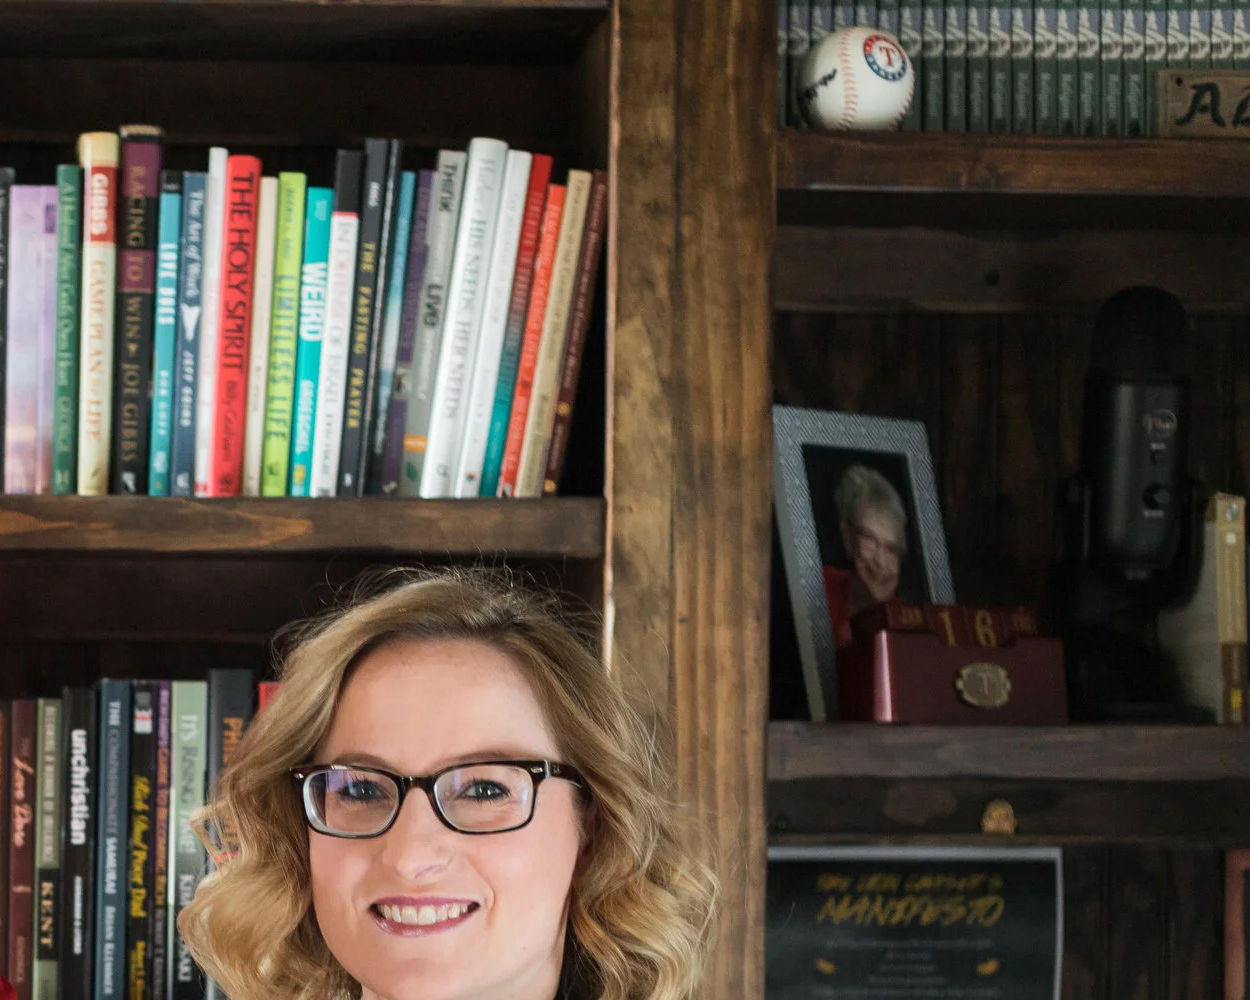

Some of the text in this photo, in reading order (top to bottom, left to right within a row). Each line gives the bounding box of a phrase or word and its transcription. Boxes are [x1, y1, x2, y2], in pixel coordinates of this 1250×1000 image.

[91, 173, 108, 235] GIBBS
[188, 221, 202, 242] Art
[125, 166, 147, 338] RACING TO WIN
[223, 172, 254, 376] THE HOLY SPIRIT
[90, 260, 106, 313] GAME
[300, 261, 328, 342] WEIRD
[89, 322, 103, 374] PLAN
[269, 275, 297, 384] LIMITLESS
[348, 242, 376, 429] THE FASTING PRAYER
[87, 401, 102, 440] LIFE
[122, 364, 141, 462] JOE GIBBS
[265, 395, 287, 441] LIFE
[974, 609, 998, 649] 6
[108, 701, 122, 726] THE
[14, 756, 34, 800] Love
[71, 729, 90, 845] unchristian
[40, 881, 55, 949] KENT
